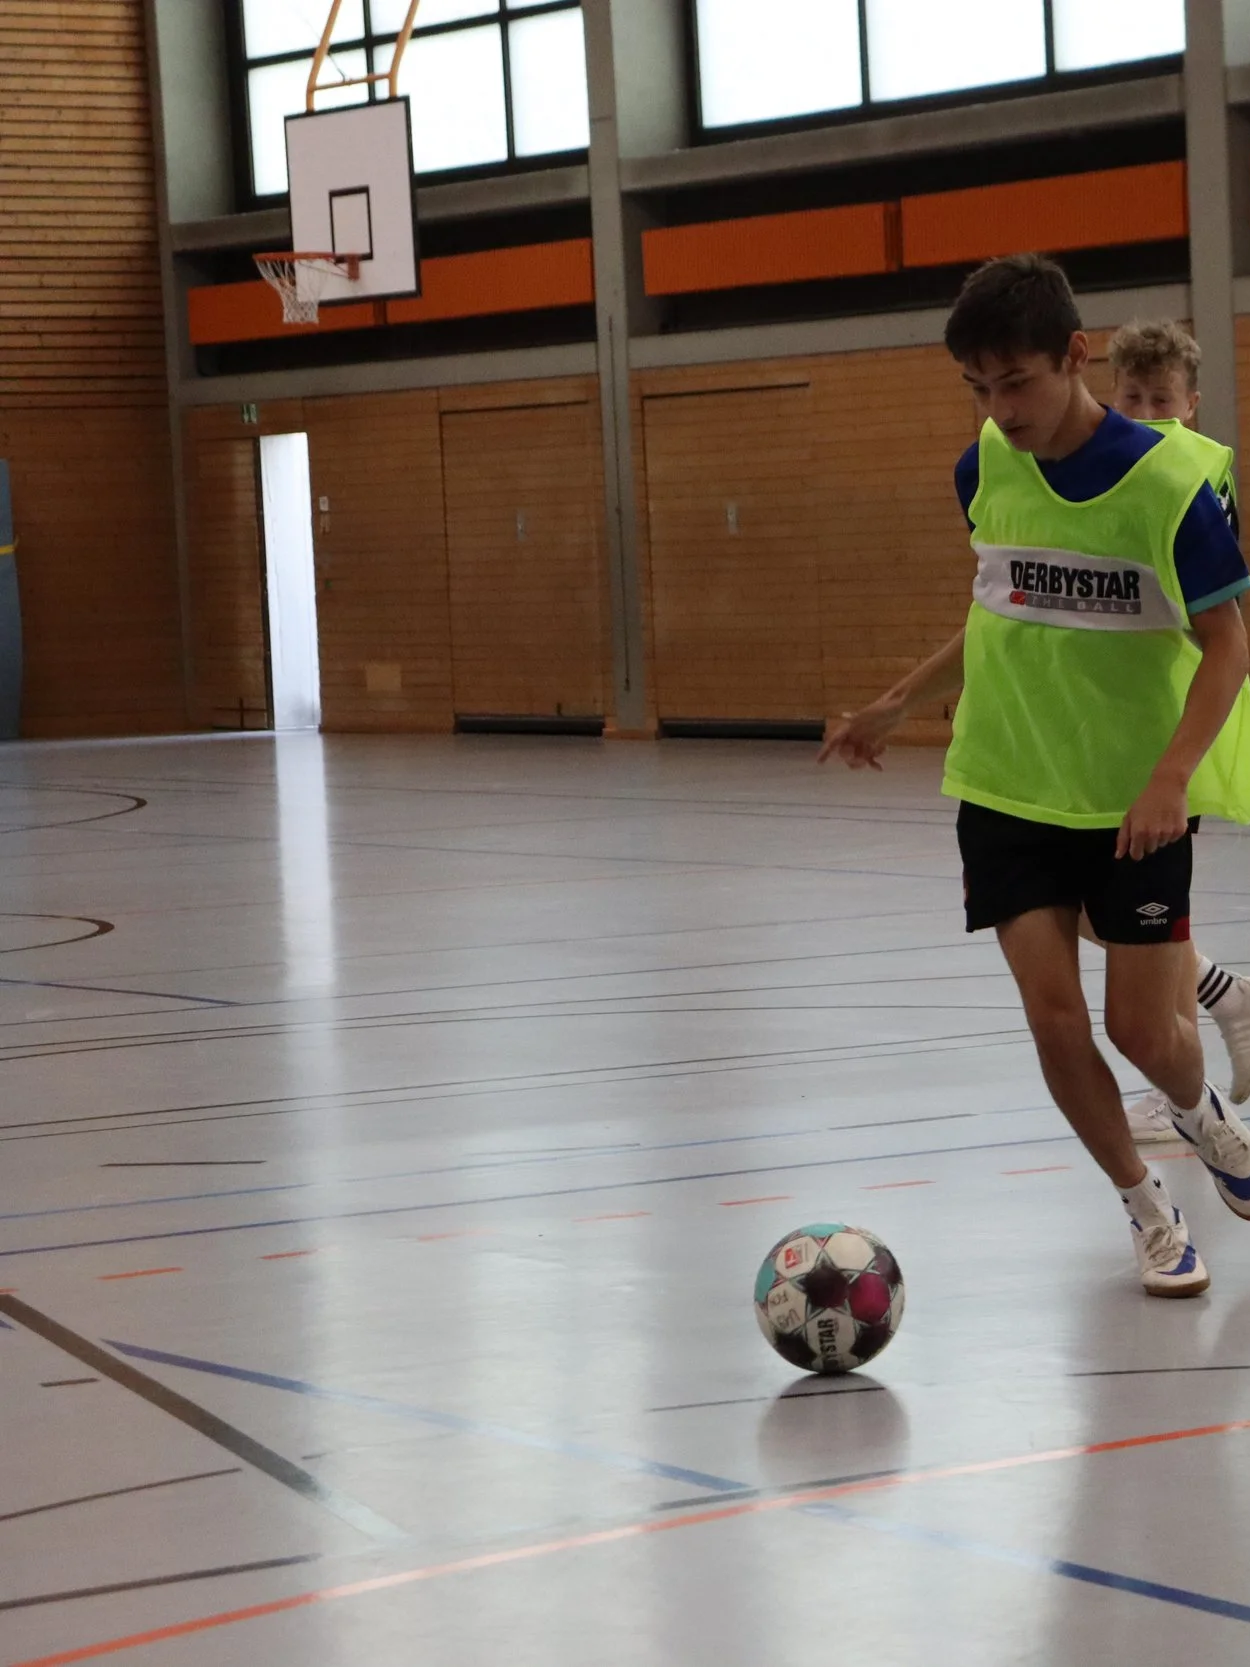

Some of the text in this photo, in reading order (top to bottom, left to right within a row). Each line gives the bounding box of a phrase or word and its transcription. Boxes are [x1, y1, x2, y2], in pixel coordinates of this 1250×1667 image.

[1009, 560, 1140, 600] DERBYSTAR
[1031, 594, 1135, 613] THE BALL
[1139, 917, 1168, 926] umbro
